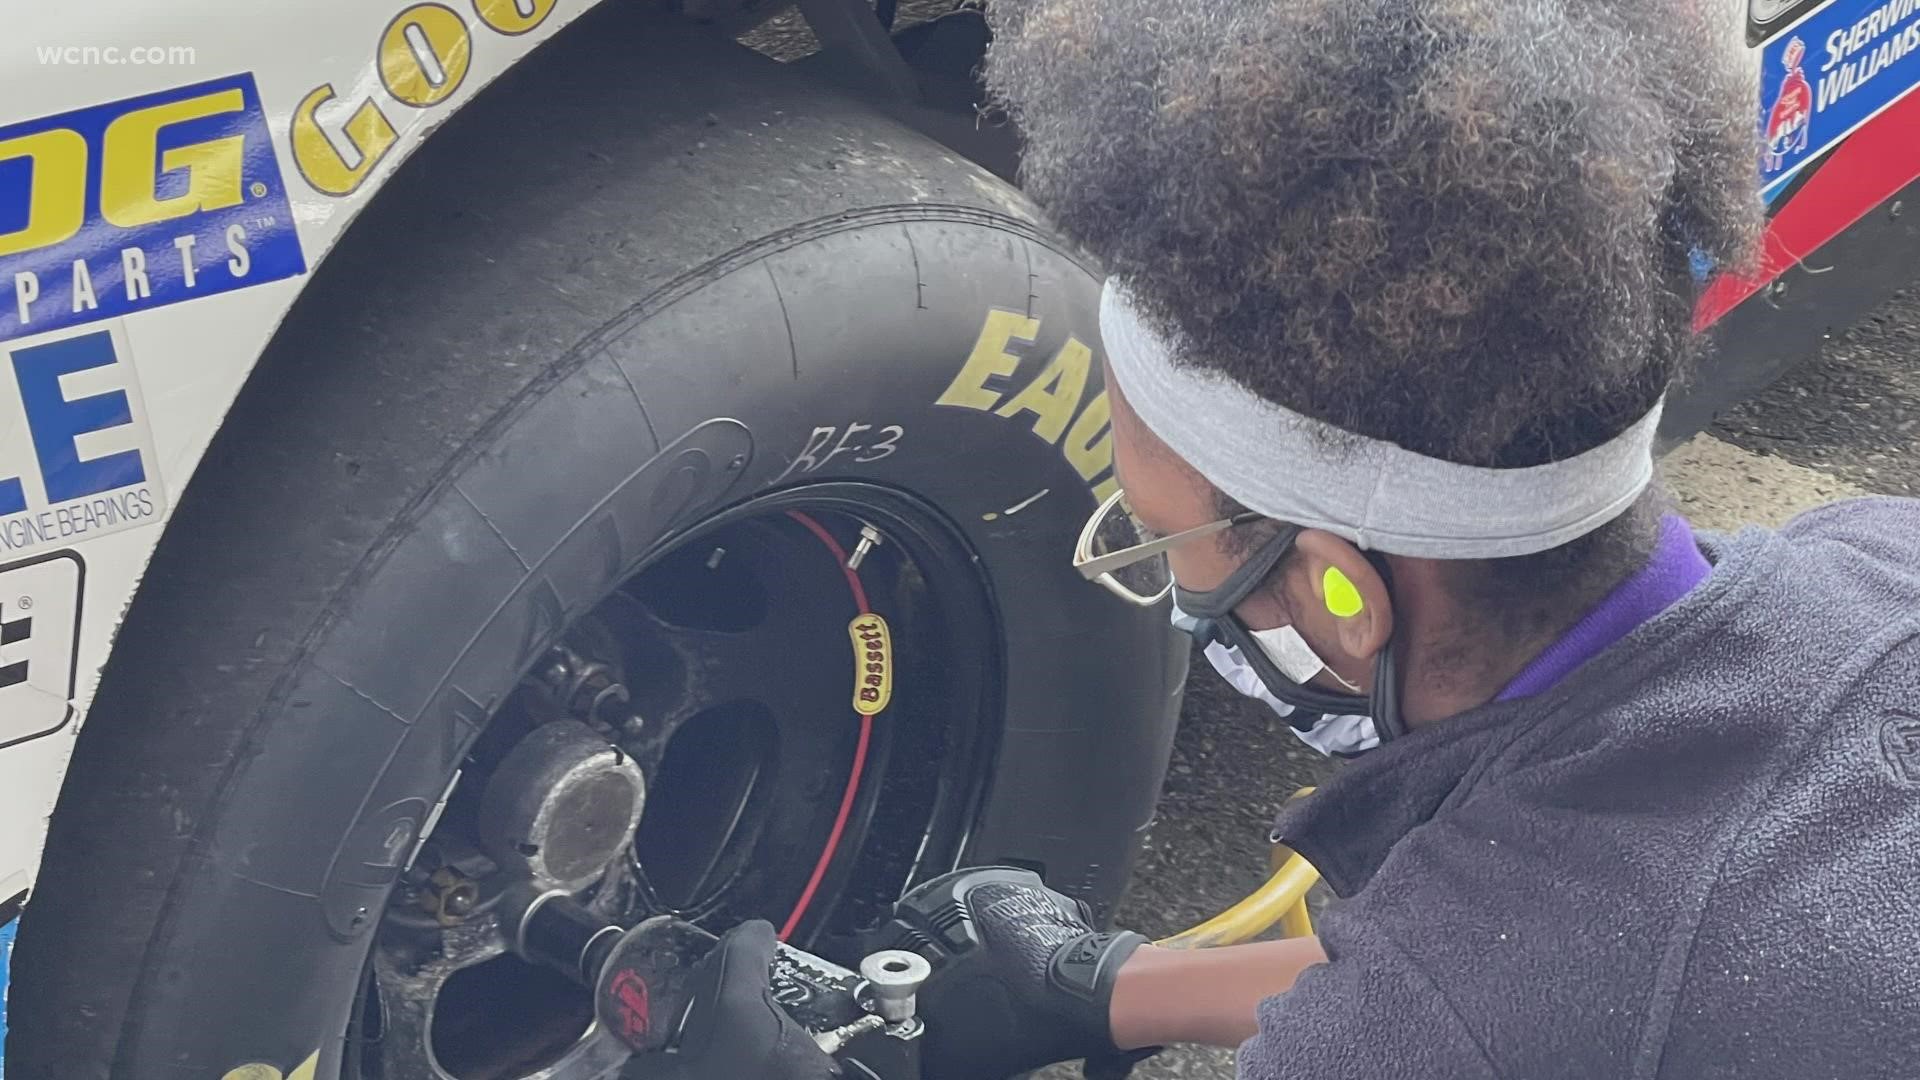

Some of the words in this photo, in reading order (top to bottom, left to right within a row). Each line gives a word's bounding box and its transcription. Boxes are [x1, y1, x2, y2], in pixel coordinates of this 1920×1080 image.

[14, 223, 251, 325] PARTS
[0, 330, 147, 517] E
[934, 308, 1122, 508] EAG
[56, 488, 154, 537] BEARINGS
[855, 622, 885, 703] Bassett
